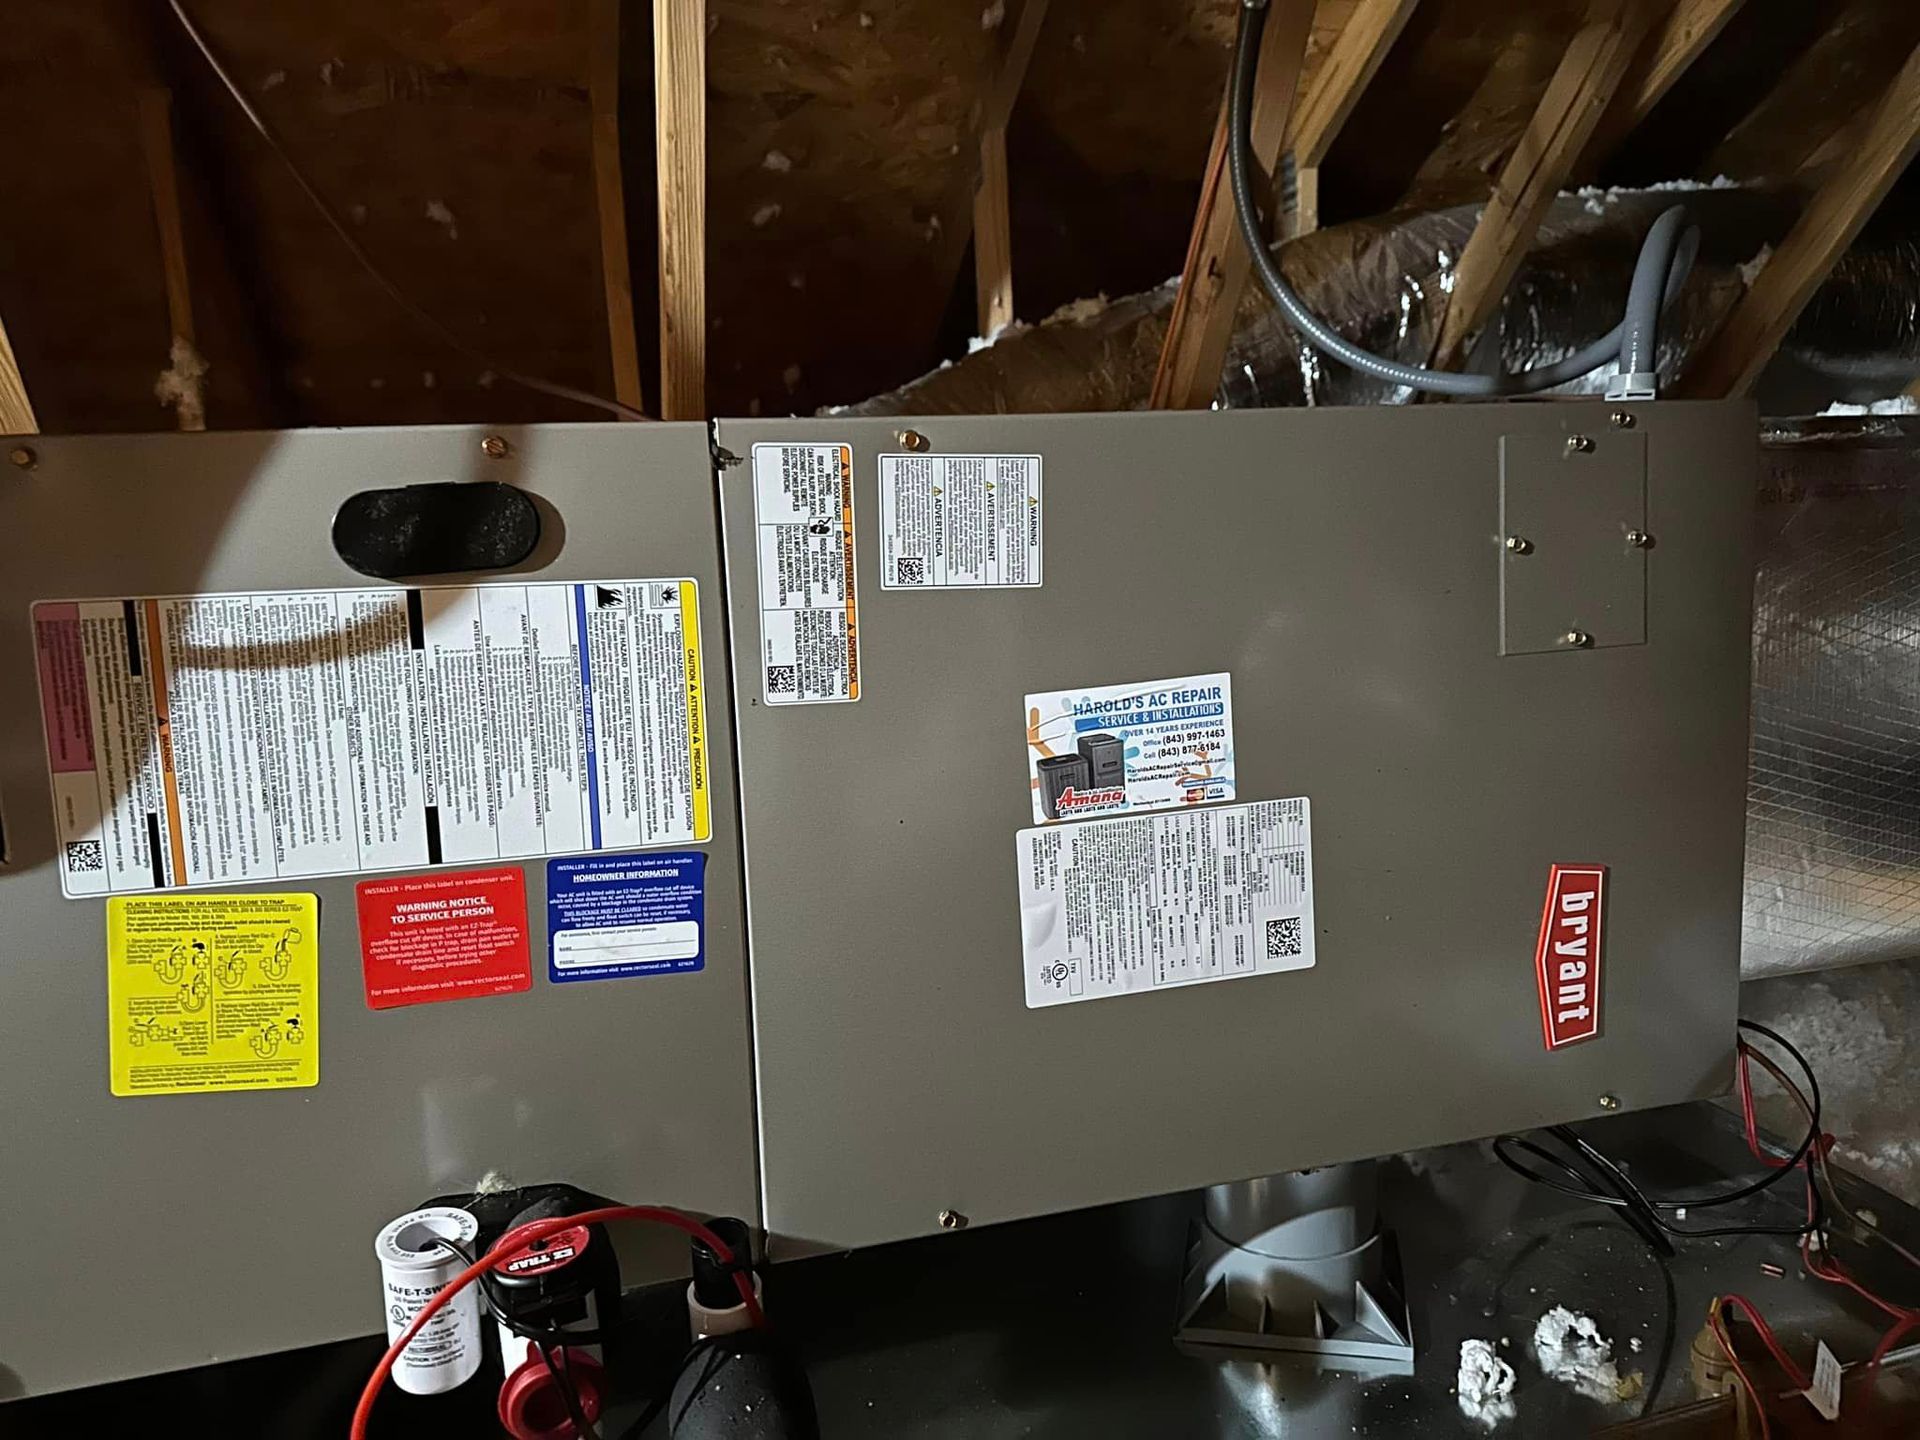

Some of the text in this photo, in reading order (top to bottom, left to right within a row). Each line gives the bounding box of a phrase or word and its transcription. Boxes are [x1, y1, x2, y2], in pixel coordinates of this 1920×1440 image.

[781, 448, 790, 492] BEFORE SERVICING.
[798, 448, 806, 477] DISCONNECT
[842, 474, 850, 507] WARNING
[934, 498, 942, 556] ADVERTENCIA
[844, 543, 853, 600] AVERTISSEMENT
[618, 619, 626, 635] FIRE
[619, 637, 628, 668] HAZARD
[848, 634, 856, 683] ADVERTENCIA
[415, 652, 426, 700] INSTALLATION
[622, 677, 630, 703] RISQUE
[134, 682, 144, 715] SERVICE
[583, 684, 591, 707] NOTICE
[623, 705, 630, 713] DE
[1073, 686, 1221, 716] HAROLD'S AC REPAIR
[419, 706, 430, 754] INSTALLATION
[584, 713, 592, 728] AVIS
[687, 648, 703, 789] CAUTION ATTENTION PRECAUCIÓN
[1098, 703, 1221, 728] SERVICE & INSTALLATIONS
[1124, 719, 1223, 737] OVER 14 YEARS EXPERIENCE
[138, 722, 149, 766] ENTRETIEN
[625, 737, 633, 764] RIESGO
[1157, 747, 1179, 758] (843)
[1182, 741, 1220, 753] 877-6184
[1162, 733, 1184, 745] (843)
[1186, 729, 1225, 740] 997-1463
[161, 733, 172, 772] WARNING
[423, 759, 434, 804] INSTALACIÓN
[627, 765, 634, 775] DE
[144, 772, 154, 808] SERVICIO
[628, 777, 636, 811] INCENDIO
[1056, 787, 1124, 809] Amana
[573, 868, 678, 883] HOMEOWNER INFORMATION
[390, 906, 494, 923] TO SERVICE PERSON
[396, 895, 486, 913] WARNING NOTICE
[1554, 891, 1595, 1024] bryant
[508, 1255, 550, 1271] TRAP
